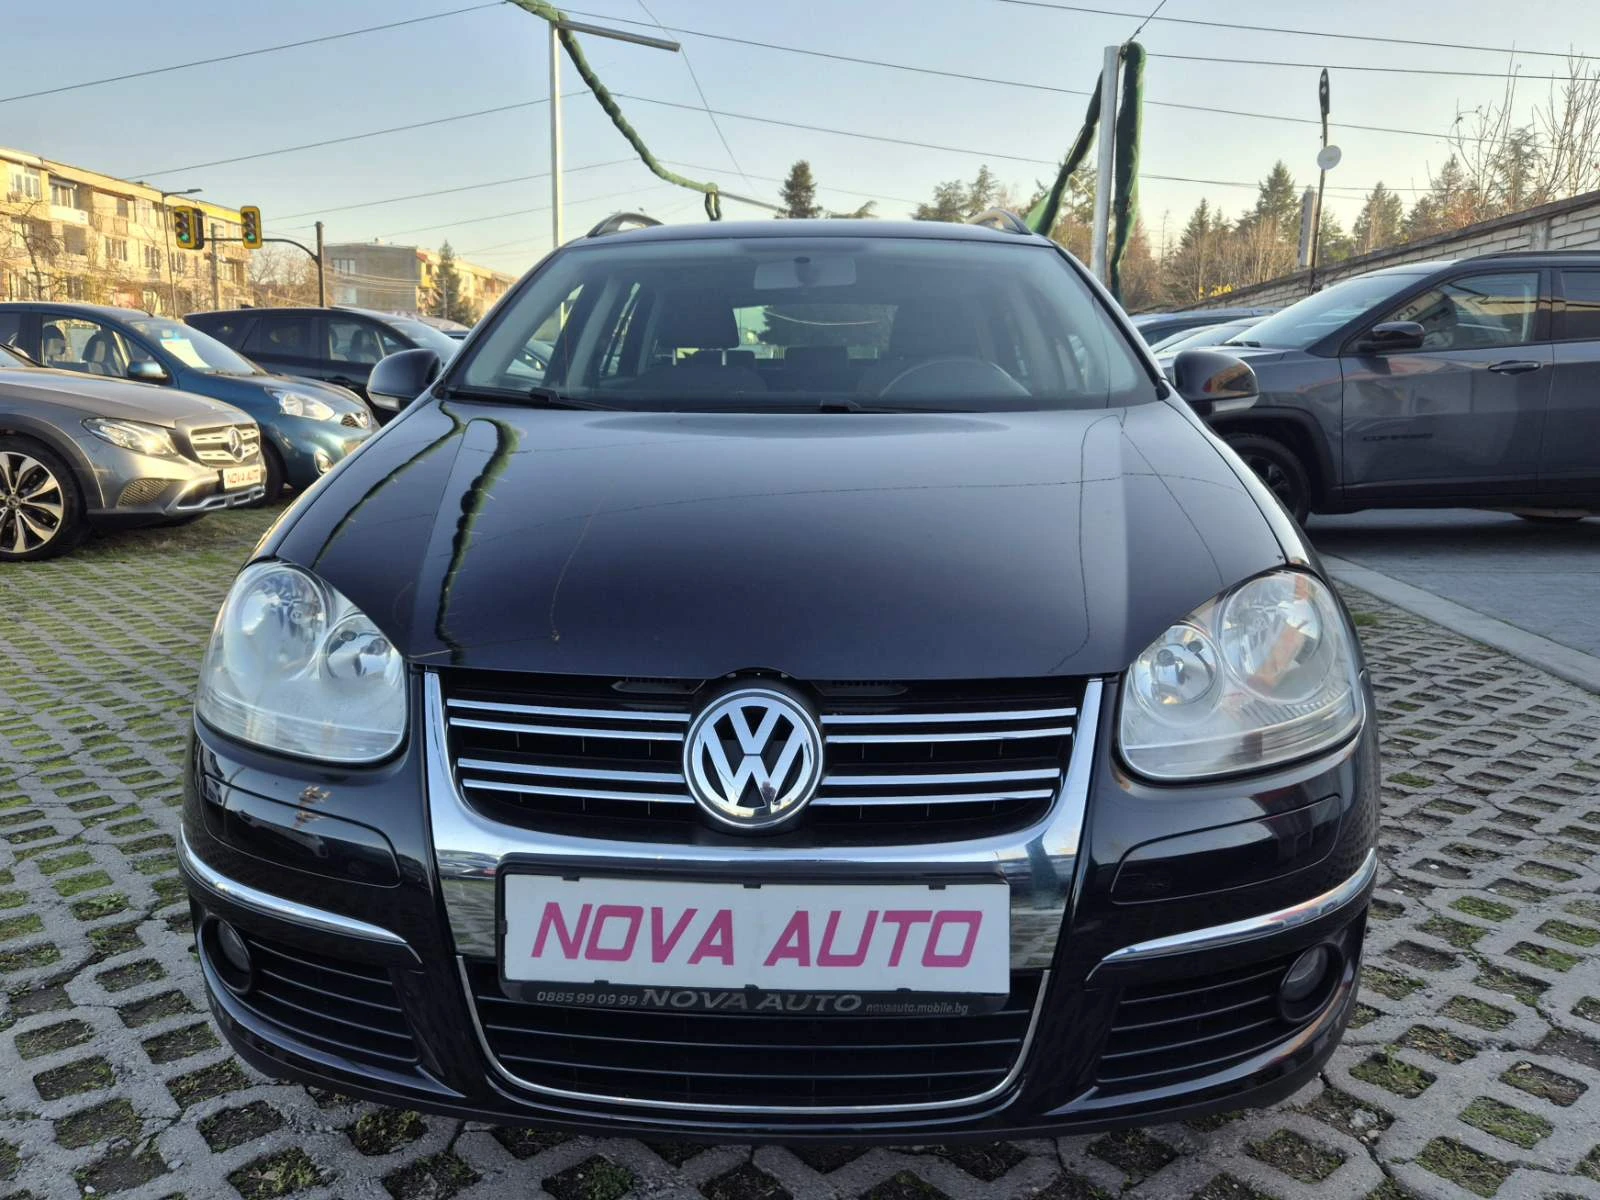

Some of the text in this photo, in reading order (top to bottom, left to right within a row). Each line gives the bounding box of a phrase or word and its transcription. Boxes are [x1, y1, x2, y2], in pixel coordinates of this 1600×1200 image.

[530, 901, 984, 968] NOVA AUTO
[536, 990, 576, 1003] 0885
[576, 992, 597, 1004] 99
[598, 993, 617, 1006] 09
[640, 988, 748, 1010] NOVA
[755, 992, 863, 1012] AUTO
